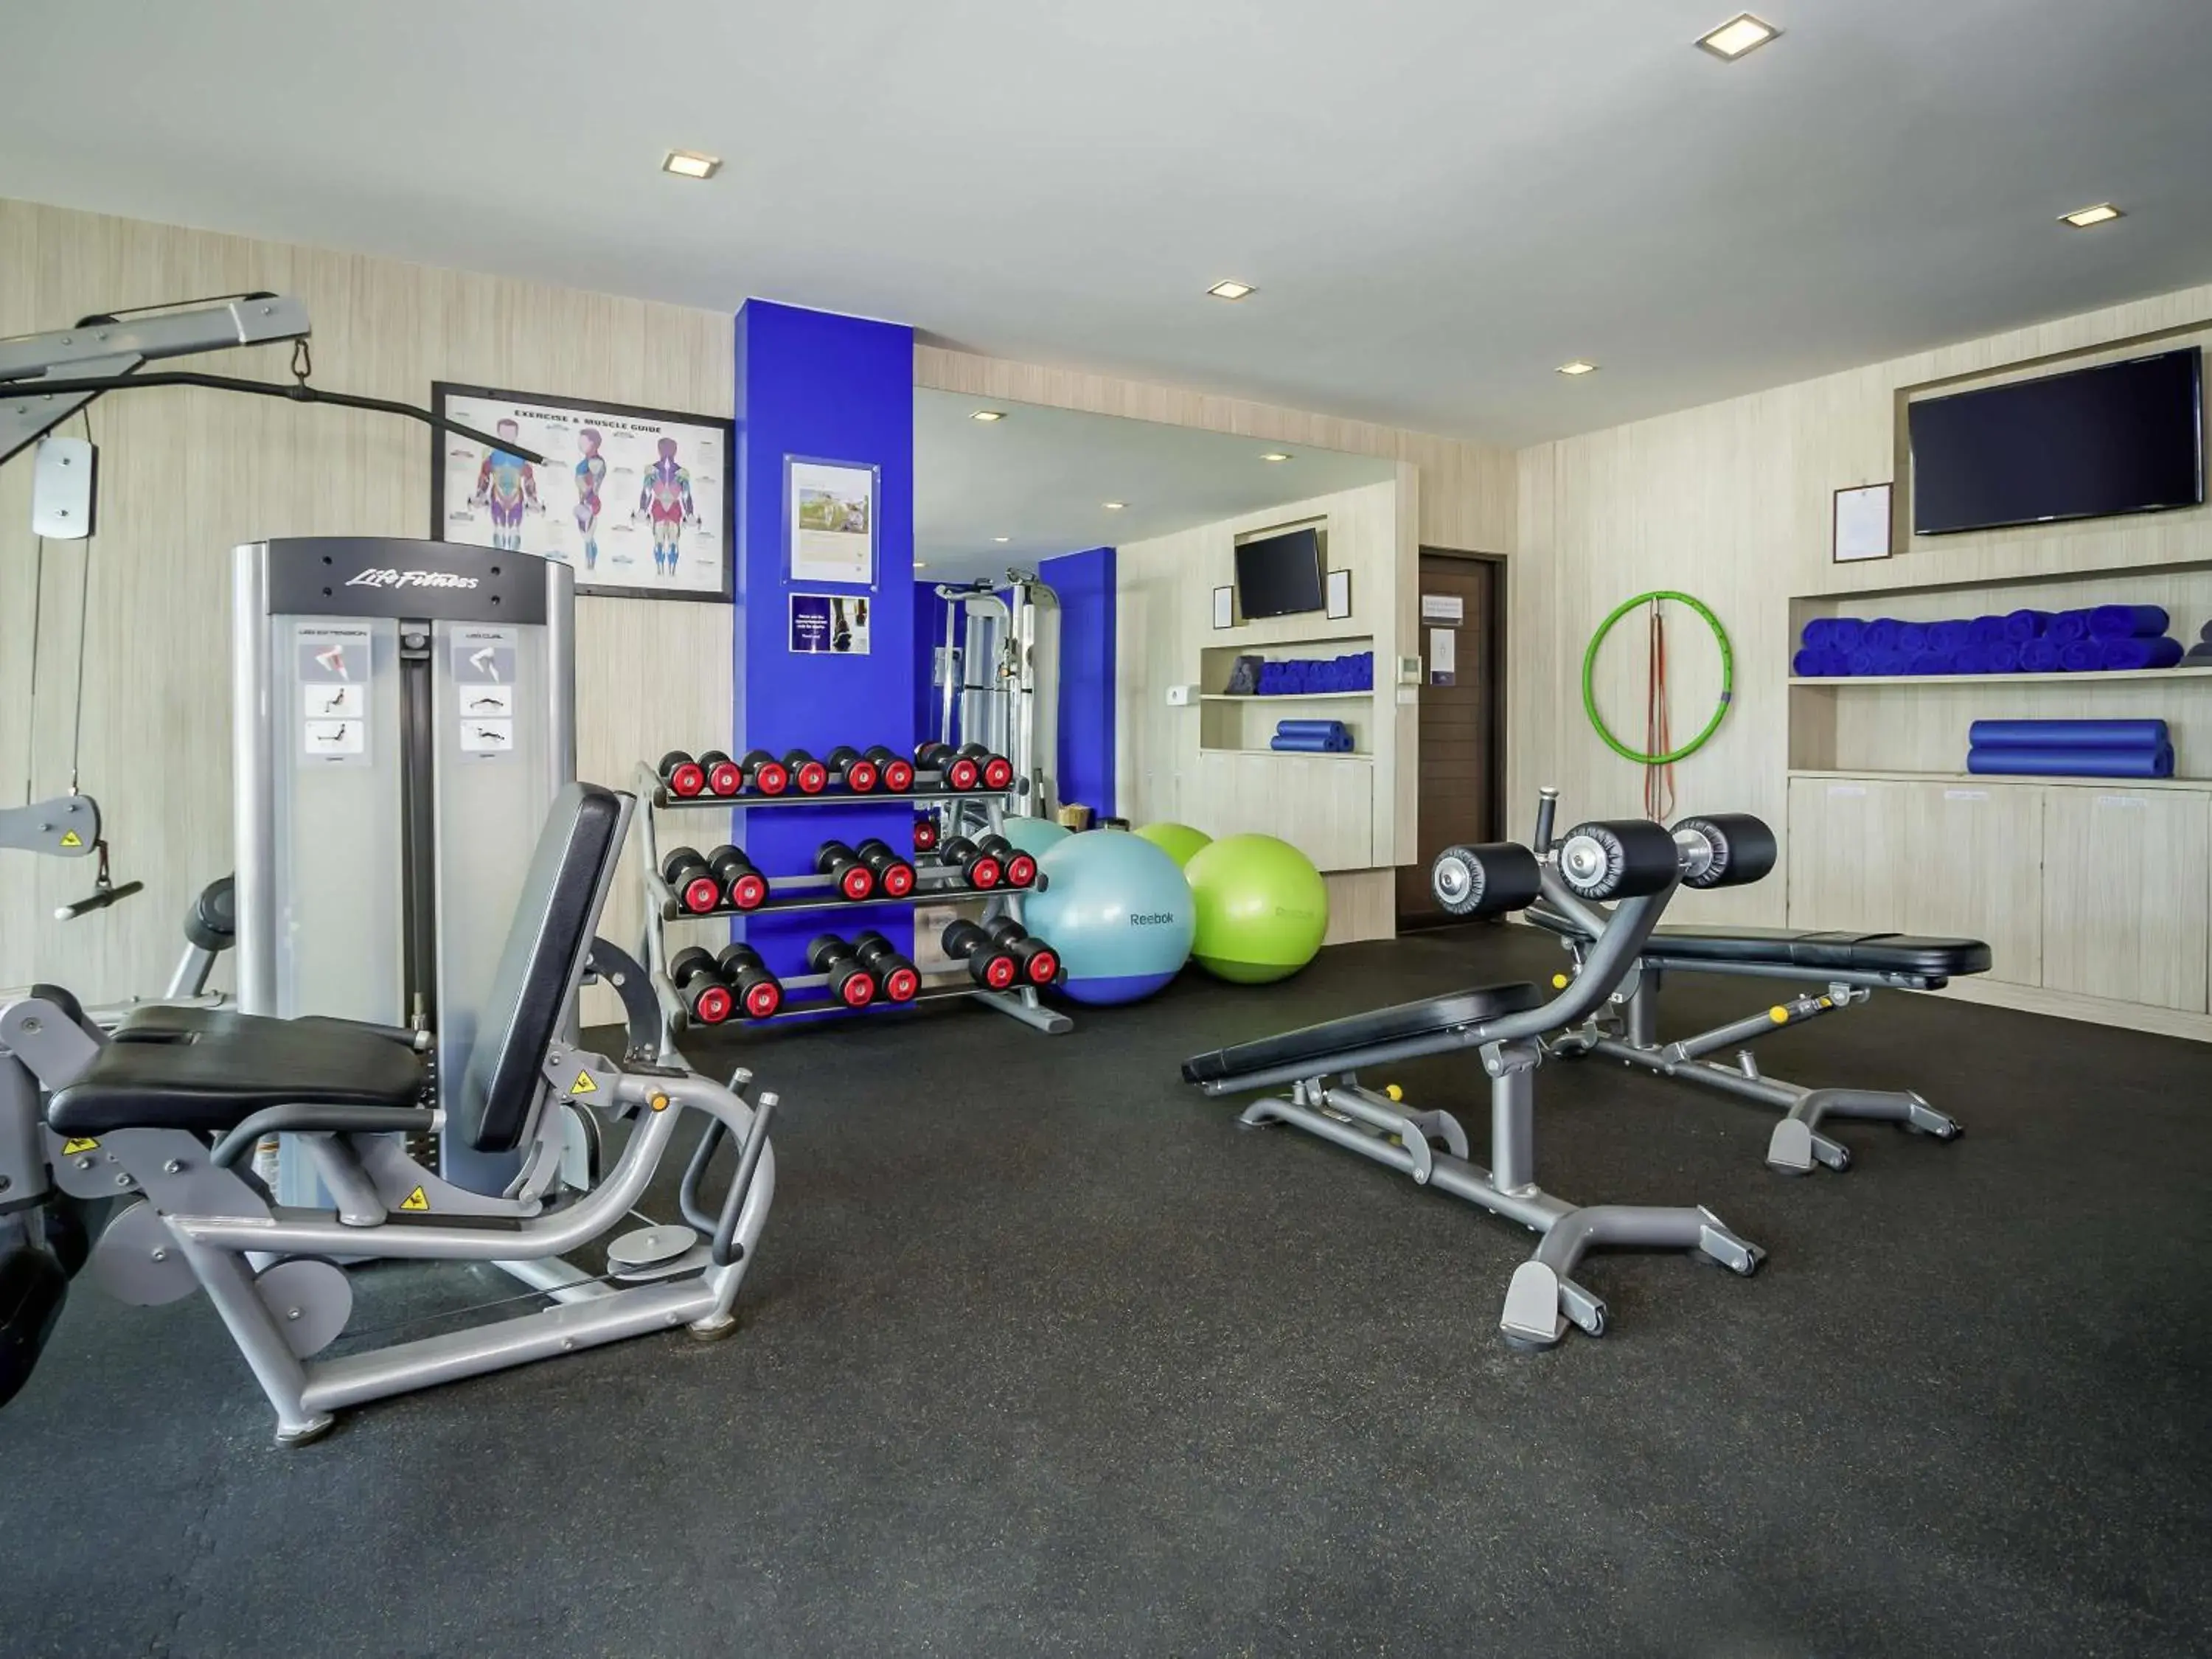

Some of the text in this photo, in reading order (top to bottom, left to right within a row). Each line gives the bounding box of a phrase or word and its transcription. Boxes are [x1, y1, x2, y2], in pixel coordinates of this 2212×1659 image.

[515, 409, 568, 422] EXERCISE
[584, 418, 627, 430] MUSCLE
[630, 425, 661, 434] GUIDE
[344, 568, 479, 588] Life Fitness
[1130, 911, 1174, 925] Reebok
